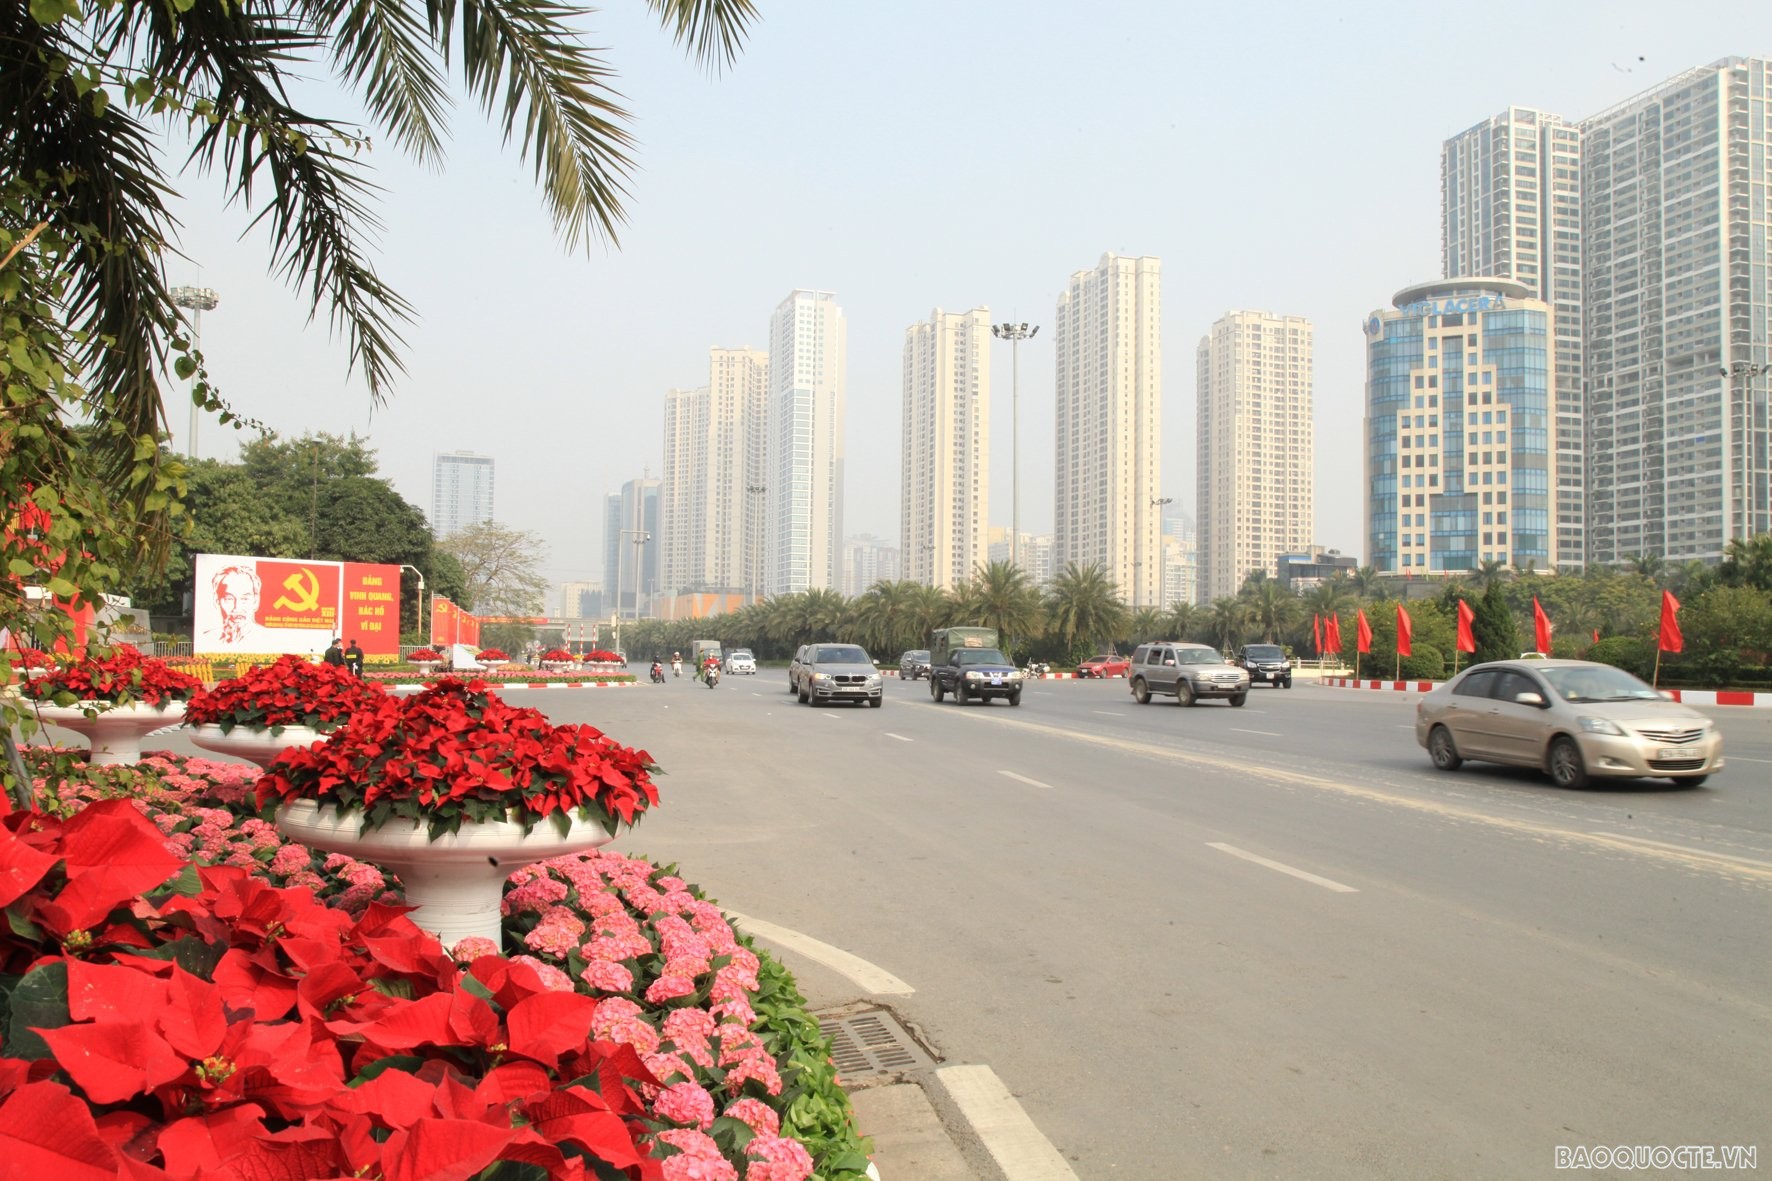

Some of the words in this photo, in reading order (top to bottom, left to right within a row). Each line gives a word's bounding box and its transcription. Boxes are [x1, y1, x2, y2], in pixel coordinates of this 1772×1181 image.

[1398, 296, 1505, 316] VIGLACERA
[349, 591, 367, 601] VINH
[358, 605, 374, 616] BÁC
